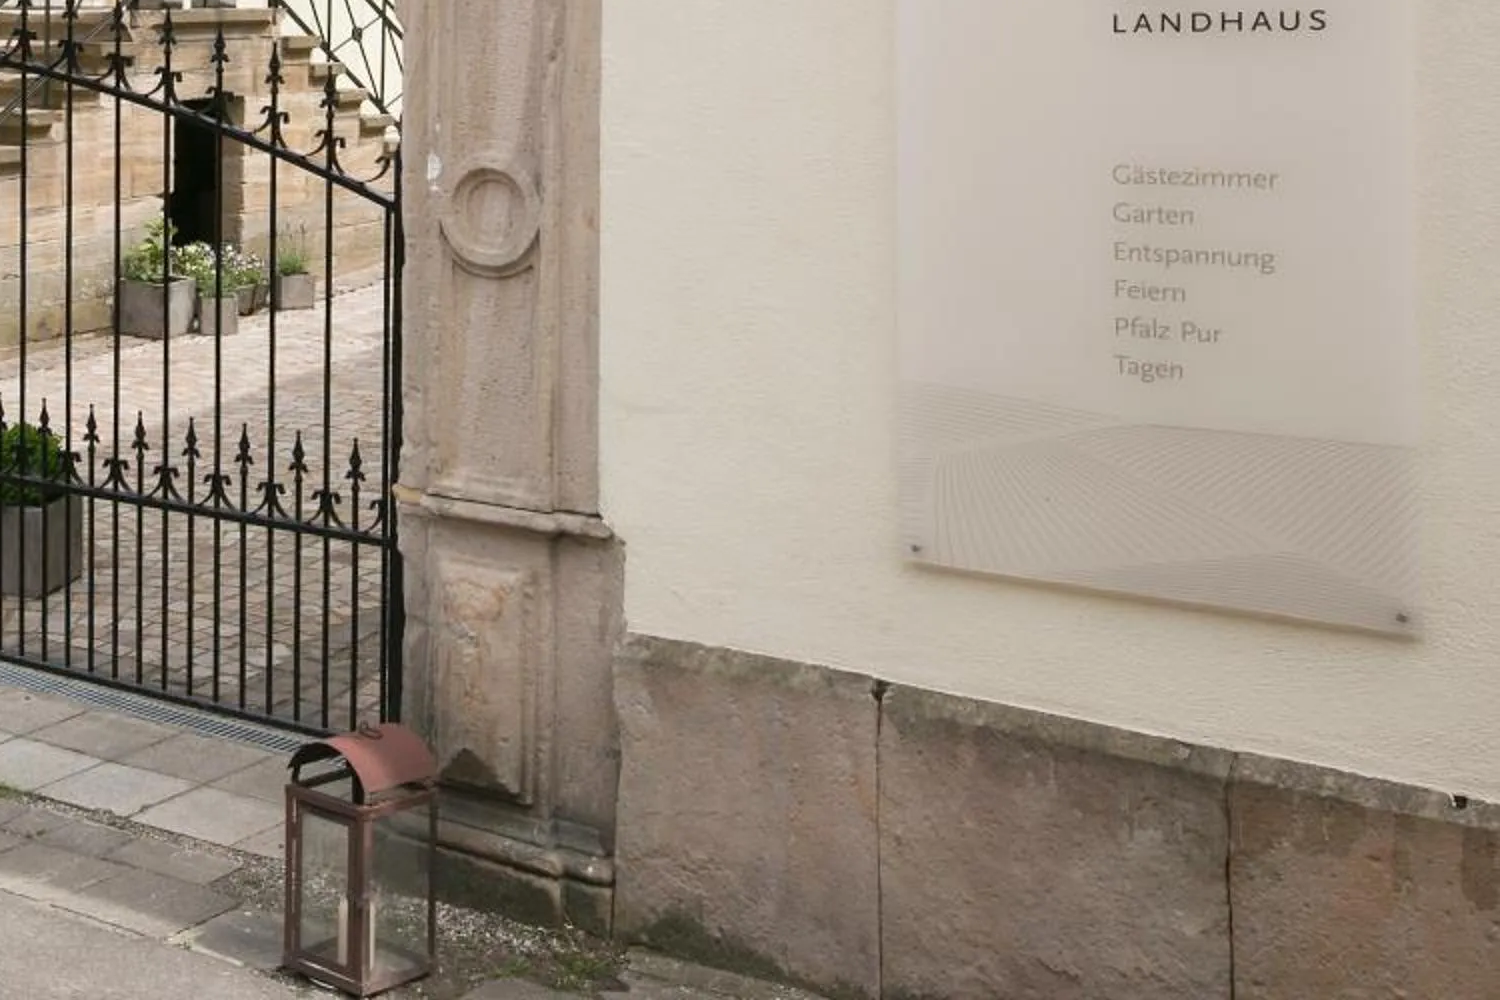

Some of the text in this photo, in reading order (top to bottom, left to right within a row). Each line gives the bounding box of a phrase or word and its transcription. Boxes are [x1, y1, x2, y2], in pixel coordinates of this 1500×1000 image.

[1112, 9, 1328, 34] LANDHAUS
[1112, 163, 1279, 190] Gästezimmer
[1112, 201, 1194, 226] Garten
[1113, 241, 1276, 275] Entspannung
[1113, 279, 1186, 303] Feiern
[1114, 316, 1221, 344] Pfalz Pur
[1113, 354, 1184, 384] Tagen
